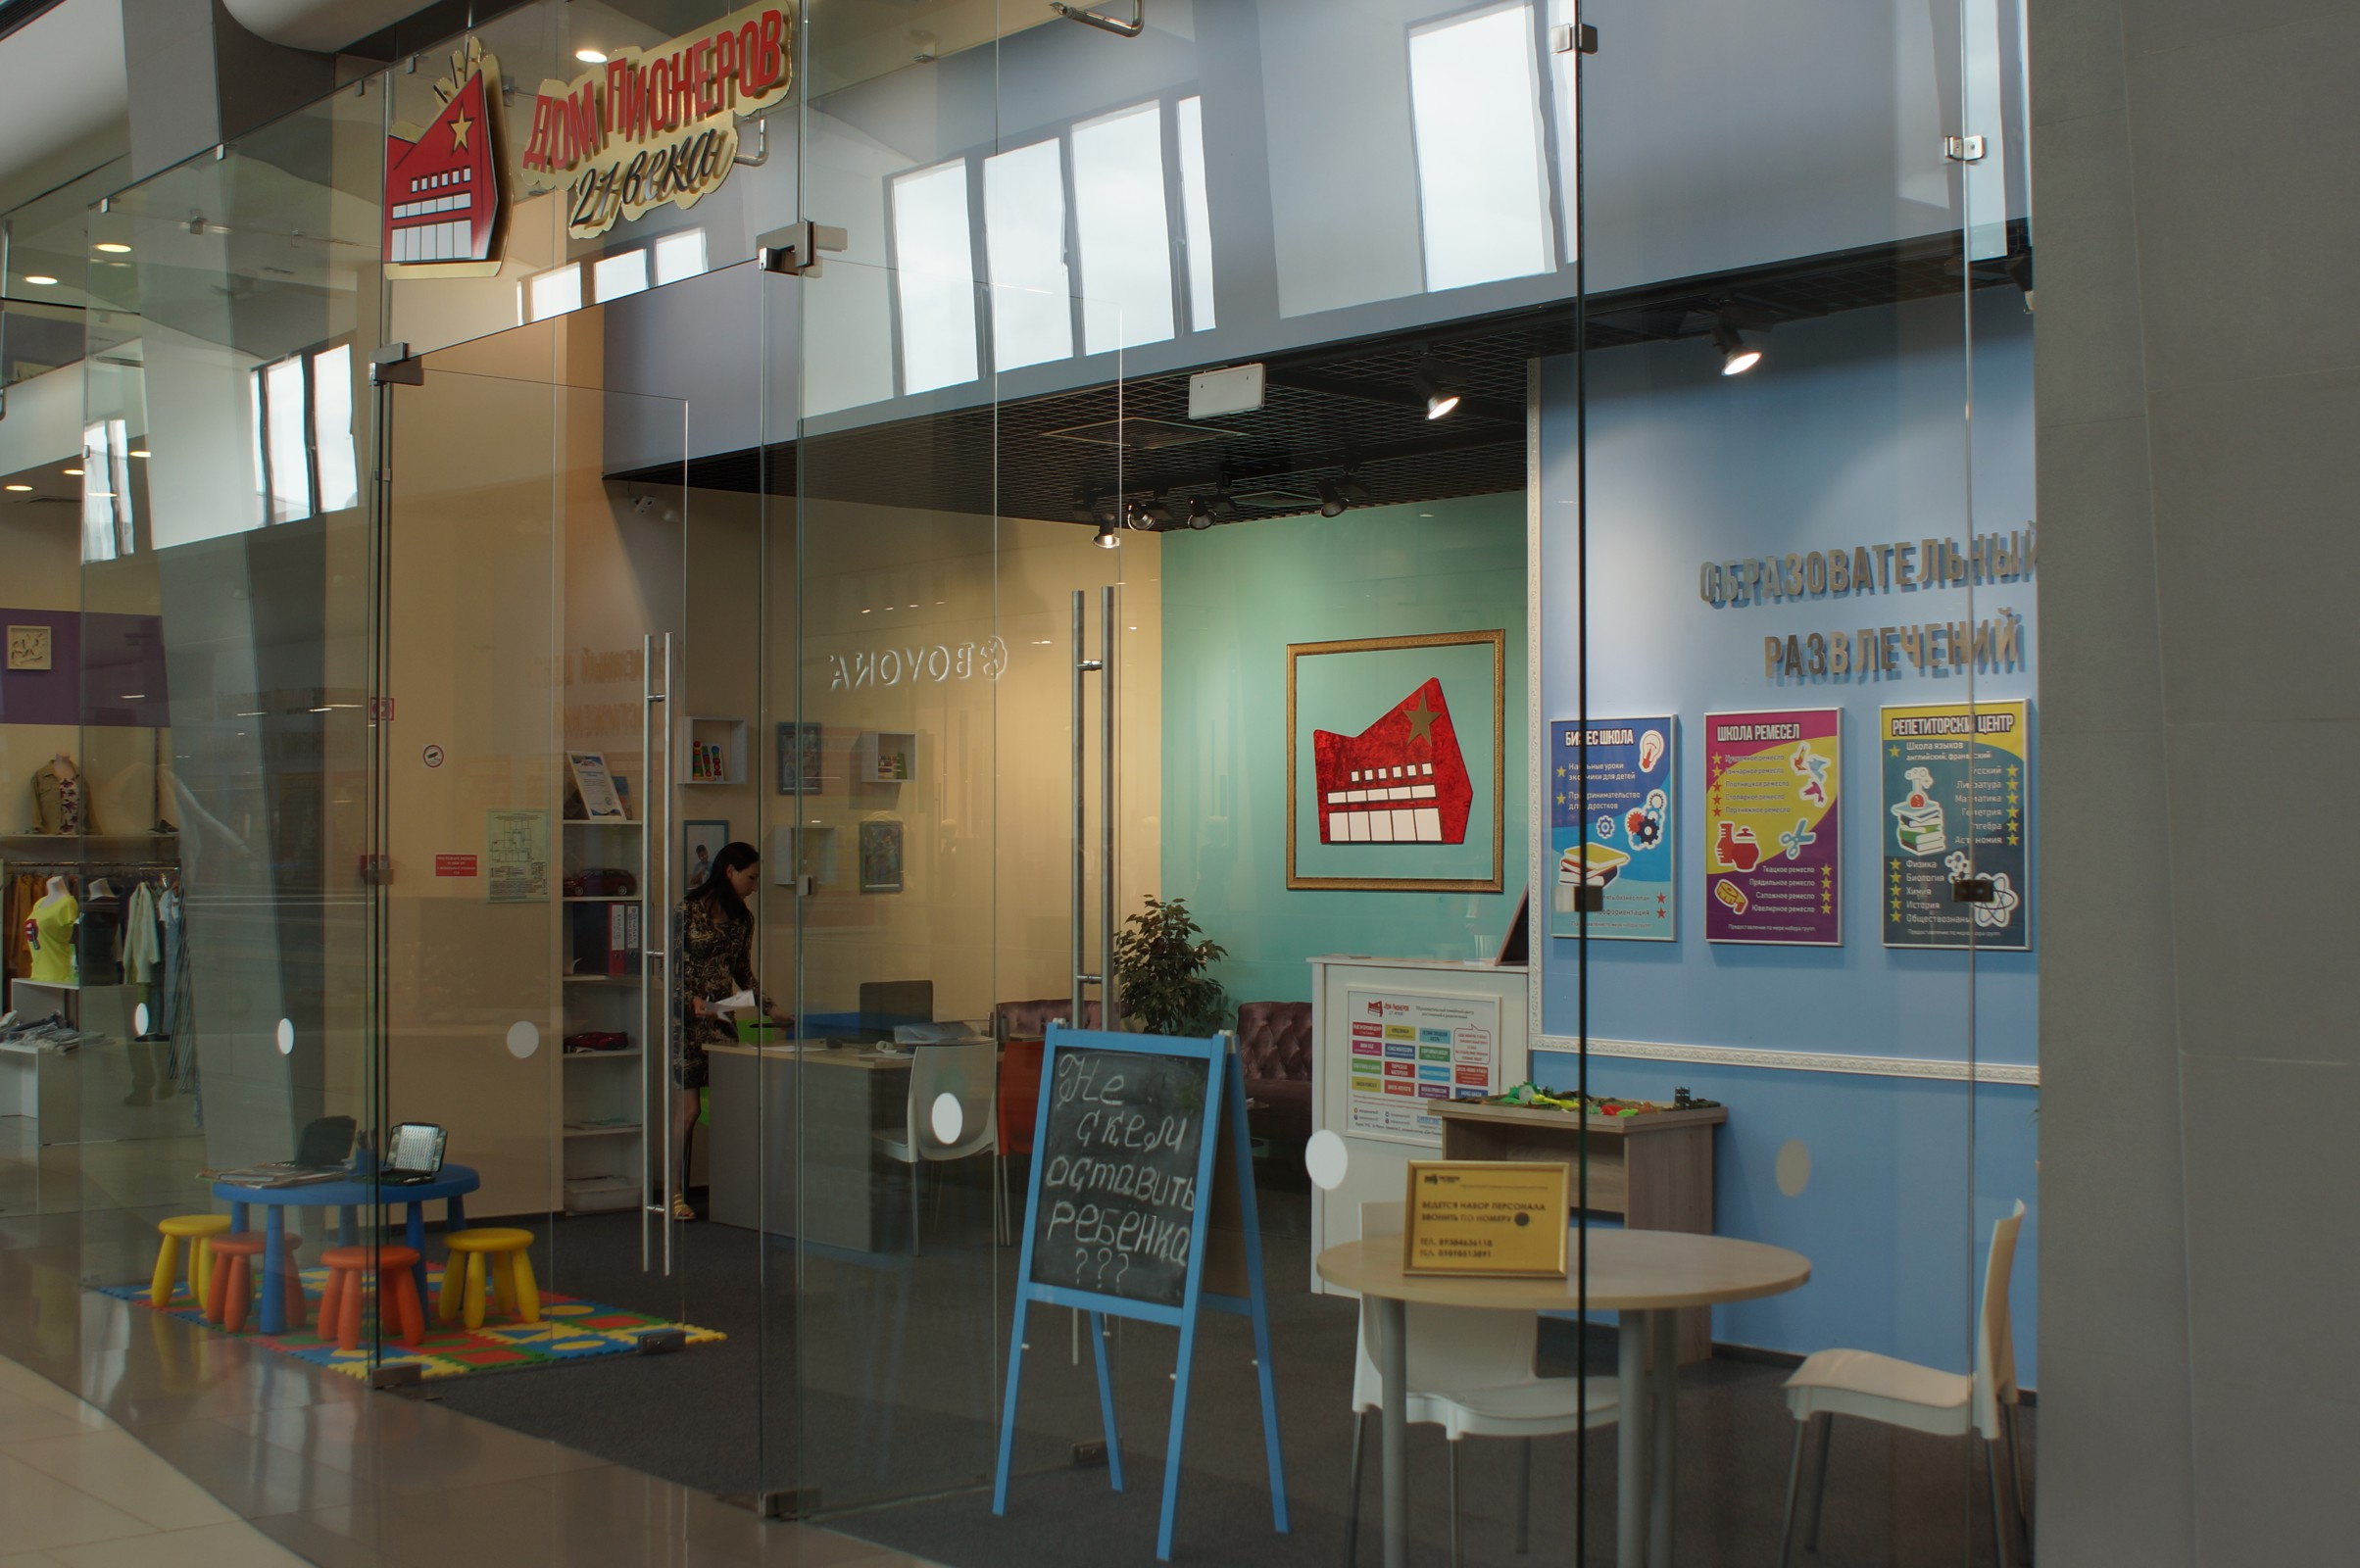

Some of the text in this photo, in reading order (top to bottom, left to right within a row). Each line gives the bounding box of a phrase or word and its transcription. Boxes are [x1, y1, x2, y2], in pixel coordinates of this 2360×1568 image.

[522, 9, 782, 172] ДОМ ПИОНЕРОВ
[570, 128, 717, 227] 21 века
[1764, 607, 2017, 677] РАЗВЛЕЧЕНИЙ
[1893, 714, 2014, 736] РЕПЕТИТОРСКИ ЦЕНТР
[1717, 723, 1800, 742] ШКОЛА РЕМЕСЕЛ
[1565, 728, 1634, 747] БИЕС ШКОЛА
[1906, 742, 1933, 751] Школа
[1604, 762, 1624, 771] уроки
[1973, 765, 2002, 774] сский
[1615, 771, 1636, 780] детей
[1956, 781, 2002, 790] Лиратура
[1568, 791, 1641, 801] Прринимательство
[1954, 794, 2002, 803] Мататика
[1961, 808, 2002, 817] Геетрия
[1974, 821, 2002, 831] лгебра
[1906, 859, 1937, 868] Физика
[1763, 865, 1788, 874] Ткацкое
[1749, 878, 1788, 887] Прядильное
[1906, 886, 1932, 895] Химия
[1751, 905, 1788, 913] Ювелирное
[1906, 900, 1940, 909] История
[1906, 913, 1972, 924] Обществознани
[1057, 1054, 1125, 1107] Не
[1046, 1154, 1196, 1211] оставить
[1422, 1200, 1546, 1211] ВЕДЕТСЯ НАБОР ПЕРСОНАЛА
[1422, 1213, 1458, 1222] ЗВОНИТЬ
[1477, 1214, 1511, 1223] НОМЕРУ
